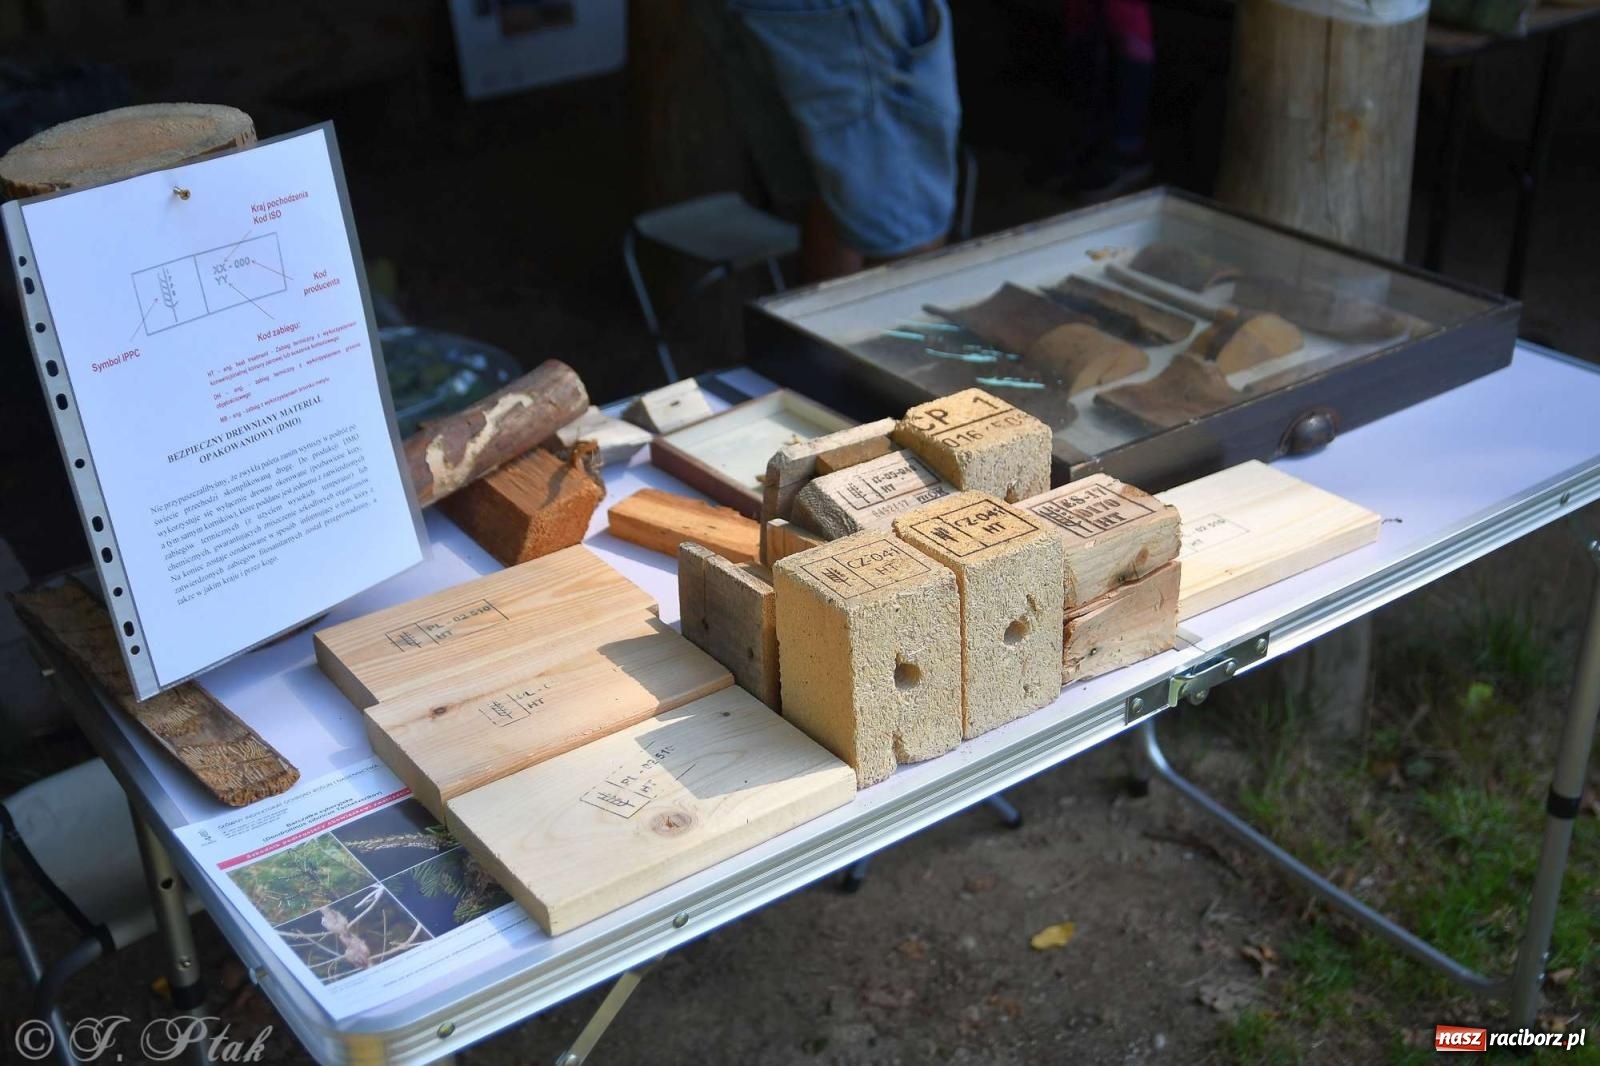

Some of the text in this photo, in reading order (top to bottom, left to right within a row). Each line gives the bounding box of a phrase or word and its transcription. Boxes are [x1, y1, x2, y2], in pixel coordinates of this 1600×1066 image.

[250, 190, 308, 214] Kraj pochodzenia
[253, 210, 281, 224] Kod ISO
[313, 269, 326, 280] Kod
[303, 277, 340, 296] producenta
[257, 320, 301, 341] Kod zabiegu:
[91, 349, 140, 373] Symbol IPPC
[908, 396, 998, 431] CP 1
[167, 435, 222, 462] BEZPIECZNY
[225, 413, 277, 439] DREWNIANY
[198, 416, 301, 463] OPAKOWANIOWY (DMO)
[955, 506, 1006, 527] CZ-041
[1094, 512, 1127, 527] HT
[982, 521, 1006, 535] HT
[846, 547, 901, 569] CZ-041
[875, 562, 899, 576] HT
[527, 697, 545, 709] HT
